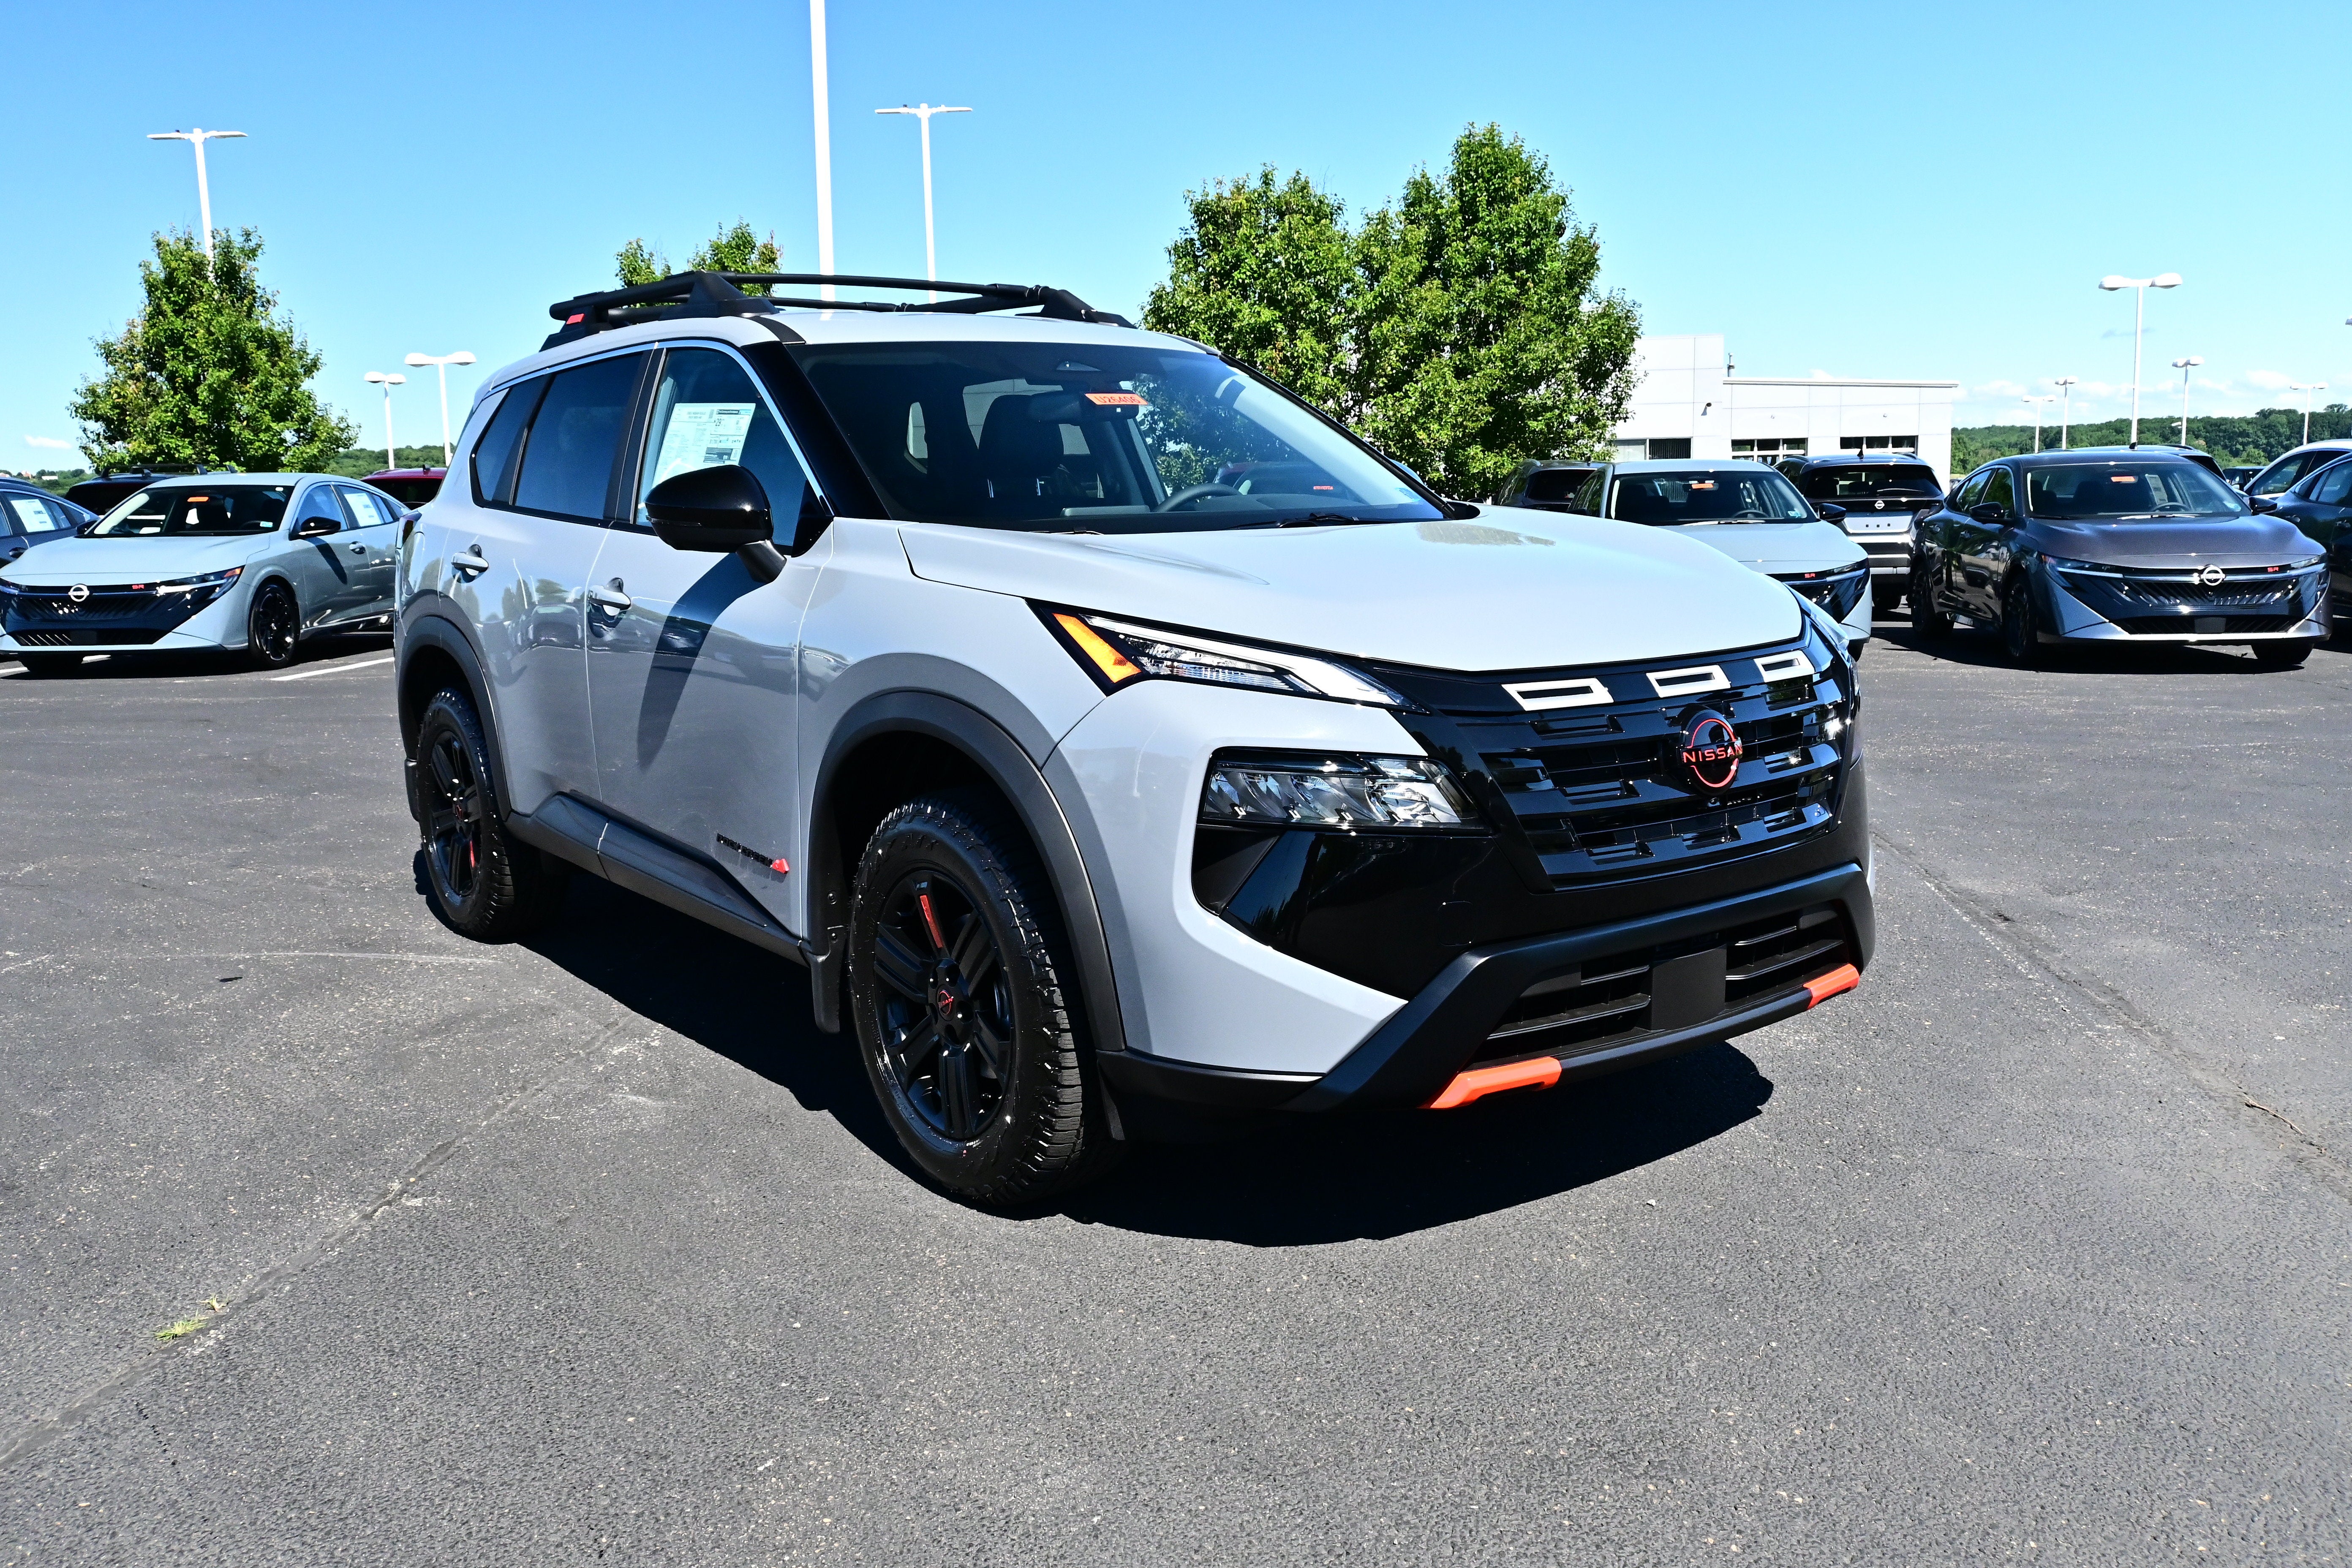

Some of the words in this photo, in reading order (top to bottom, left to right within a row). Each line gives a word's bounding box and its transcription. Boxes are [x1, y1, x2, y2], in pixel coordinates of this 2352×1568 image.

[715, 418, 721, 427] 29
[1682, 744, 1743, 763] NISSAN
[938, 997, 953, 1008] SSAN
